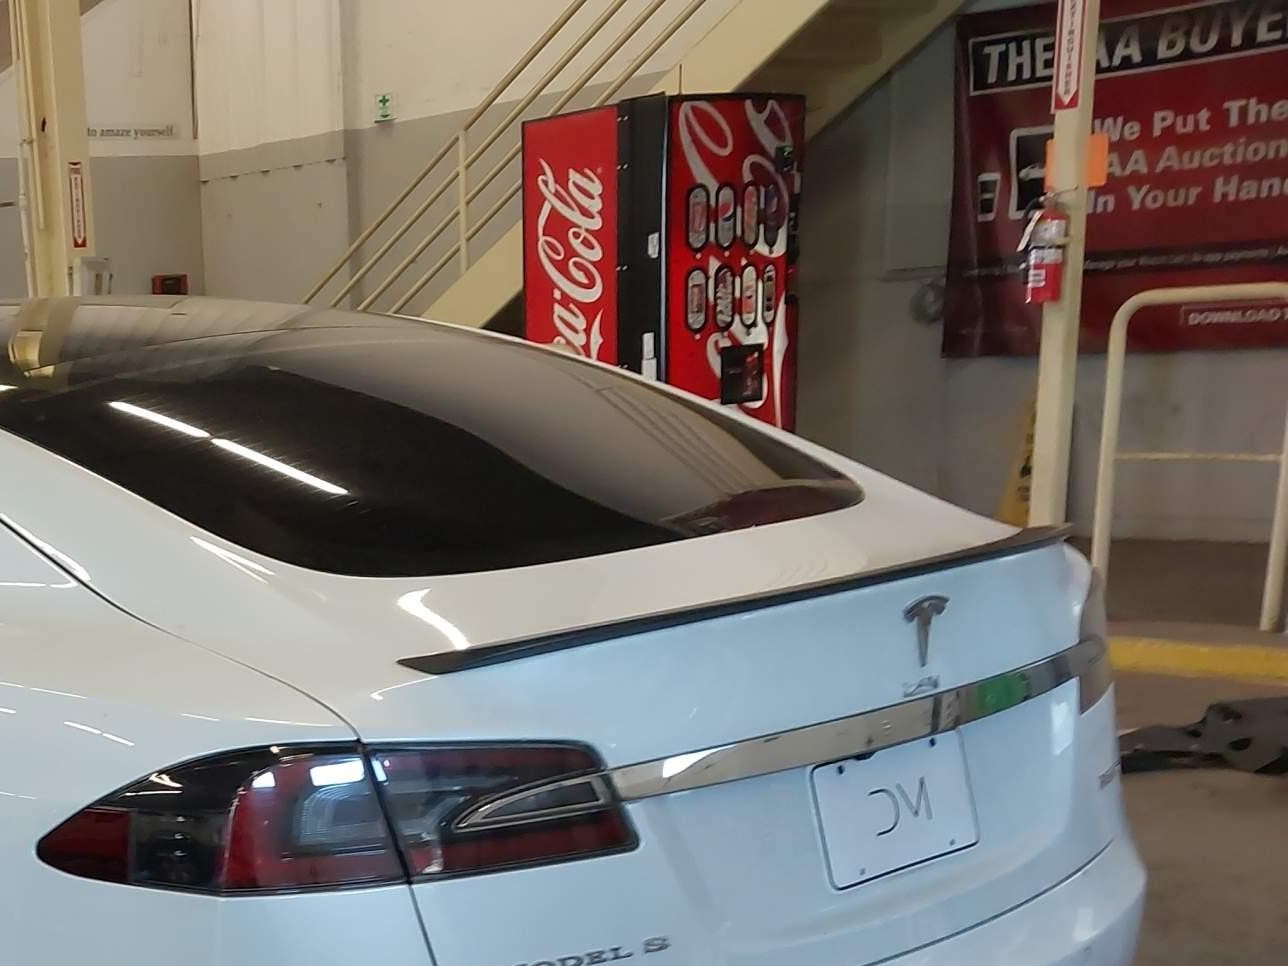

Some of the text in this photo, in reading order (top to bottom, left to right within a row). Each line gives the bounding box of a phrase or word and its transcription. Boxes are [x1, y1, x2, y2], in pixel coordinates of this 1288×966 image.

[983, 36, 1056, 84] THE
[1157, 4, 1288, 60] BUYE
[100, 128, 132, 137] amaze
[1094, 116, 1141, 142] We
[1153, 107, 1211, 137] Put
[1087, 190, 1115, 214] In
[1127, 175, 1202, 211] Your
[1188, 307, 1281, 325] DOWNLOAD
[643, 936, 672, 954] S
